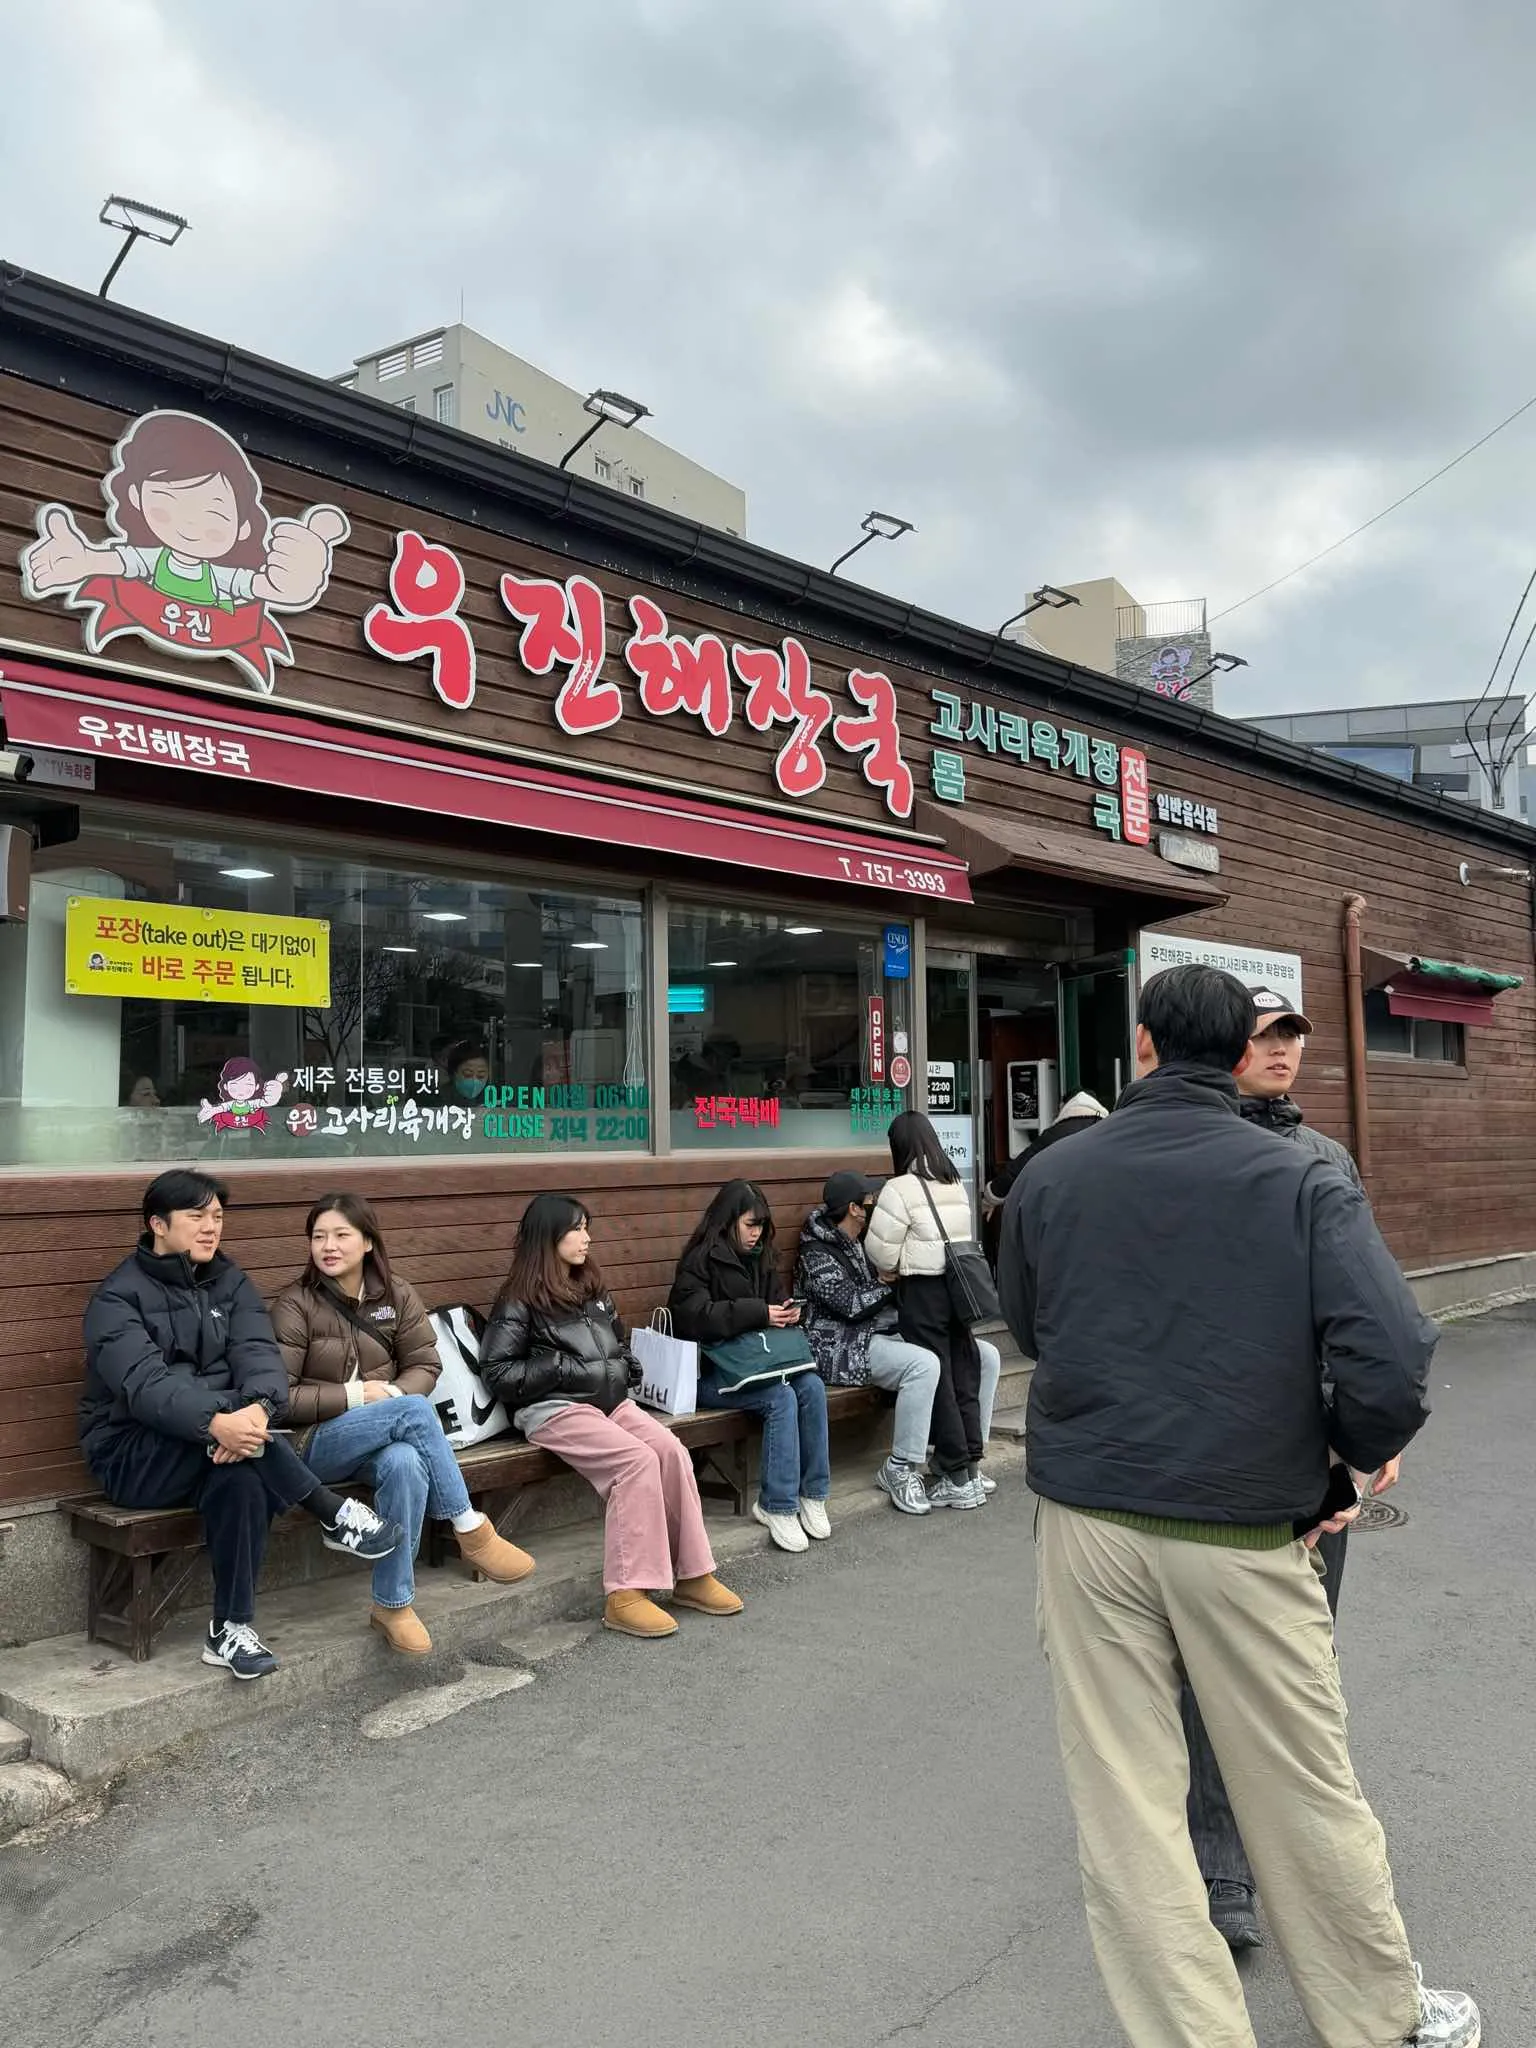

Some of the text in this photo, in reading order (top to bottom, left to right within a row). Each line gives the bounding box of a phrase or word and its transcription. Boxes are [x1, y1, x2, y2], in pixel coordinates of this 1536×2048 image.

[486, 389, 526, 433] JNC
[160, 603, 212, 642] 우진
[365, 531, 914, 818] 우진해장국
[78, 715, 252, 774] 우진해장국
[931, 688, 1119, 785] 고사리육개장
[1124, 756, 1150, 838] 전문
[1156, 793, 1218, 834] 일반음식점
[95, 915, 316, 957] 포장(take out)은 대기없이
[142, 955, 295, 988] 바로 주문 됩니다.
[872, 1010, 883, 1073] OPEN
[293, 1066, 440, 1095] 제주 전통의 맛!
[484, 1085, 545, 1110] OPEN
[286, 1097, 476, 1142] 우진 고사리육개장
[484, 1114, 648, 1142] CLOSE 저녁 22:00
[694, 1096, 779, 1129] 전국택배
